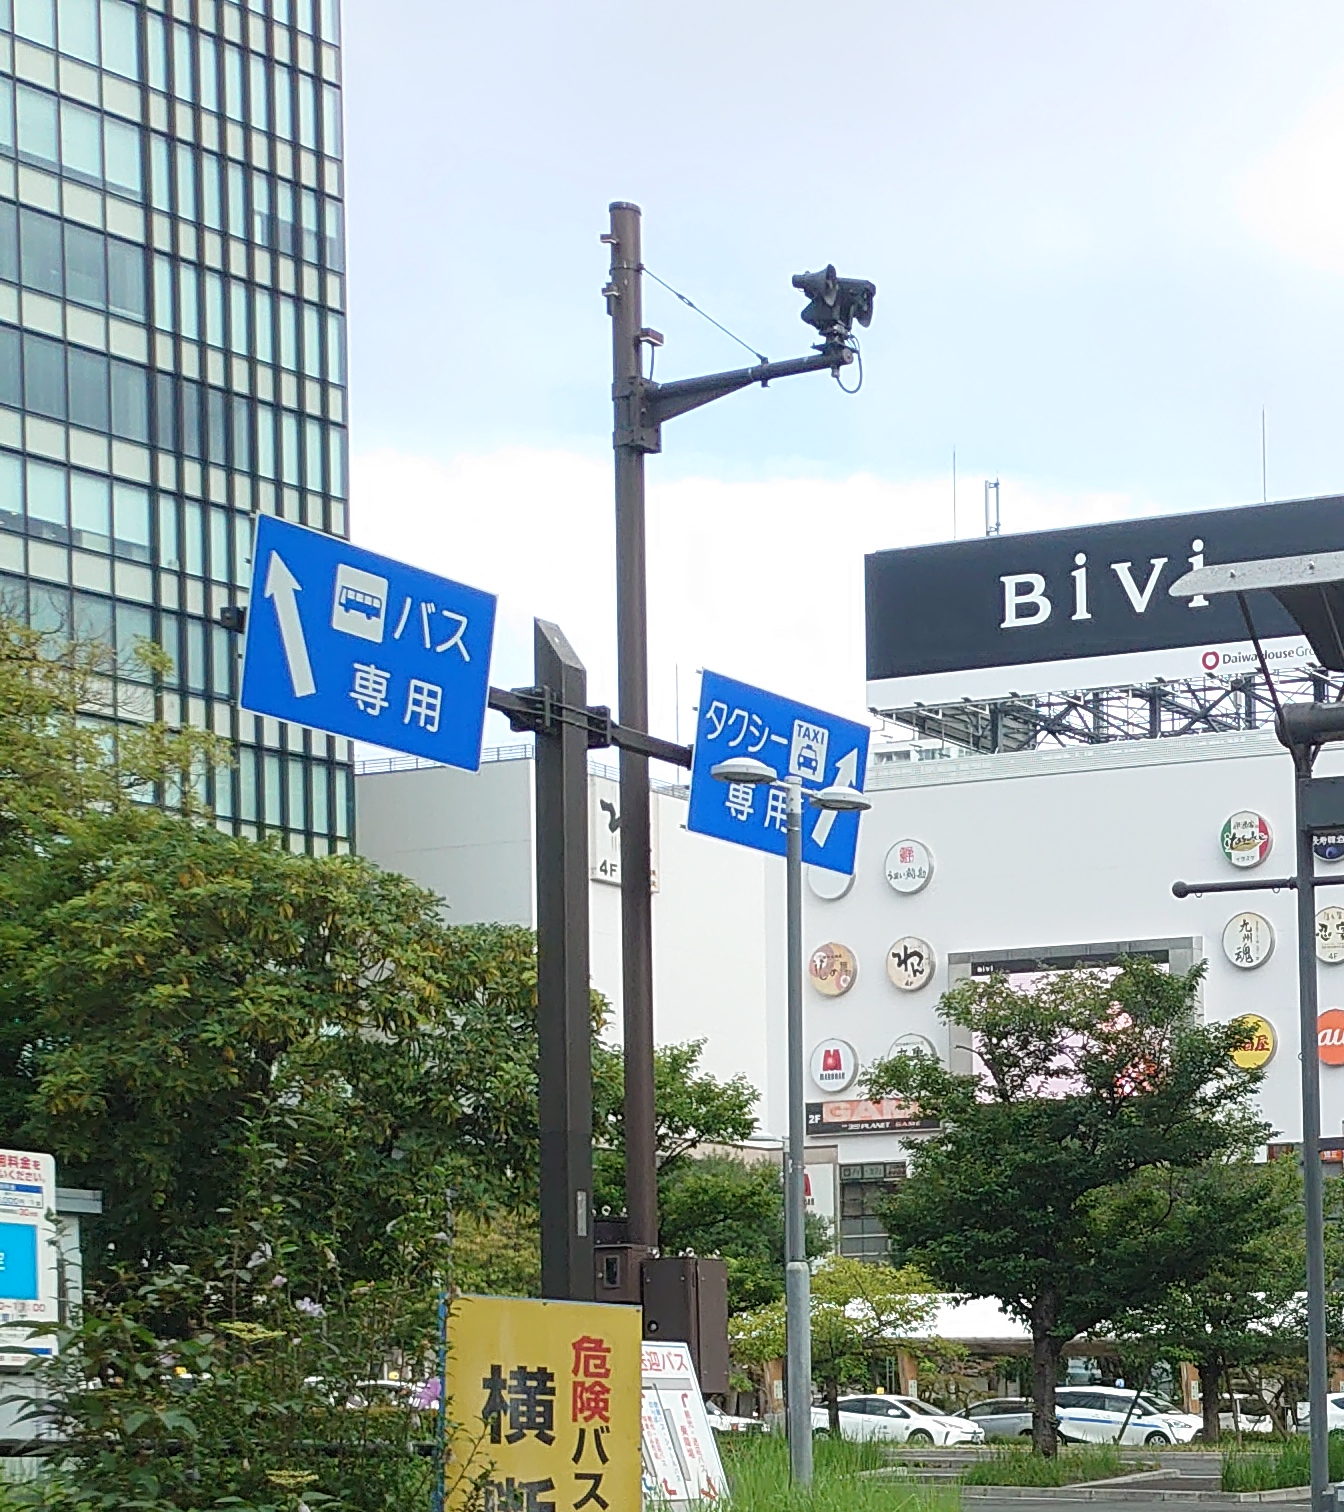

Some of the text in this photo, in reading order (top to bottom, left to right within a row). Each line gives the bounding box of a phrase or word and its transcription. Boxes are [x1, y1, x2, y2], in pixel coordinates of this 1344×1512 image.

[394, 595, 470, 664] バス
[348, 662, 443, 734] 専用
[706, 701, 788, 752] タクシー
[797, 724, 824, 744] TAXI
[600, 859, 617, 877] 4F
[1235, 919, 1253, 963] 九州魂
[809, 1115, 820, 1124] 2F
